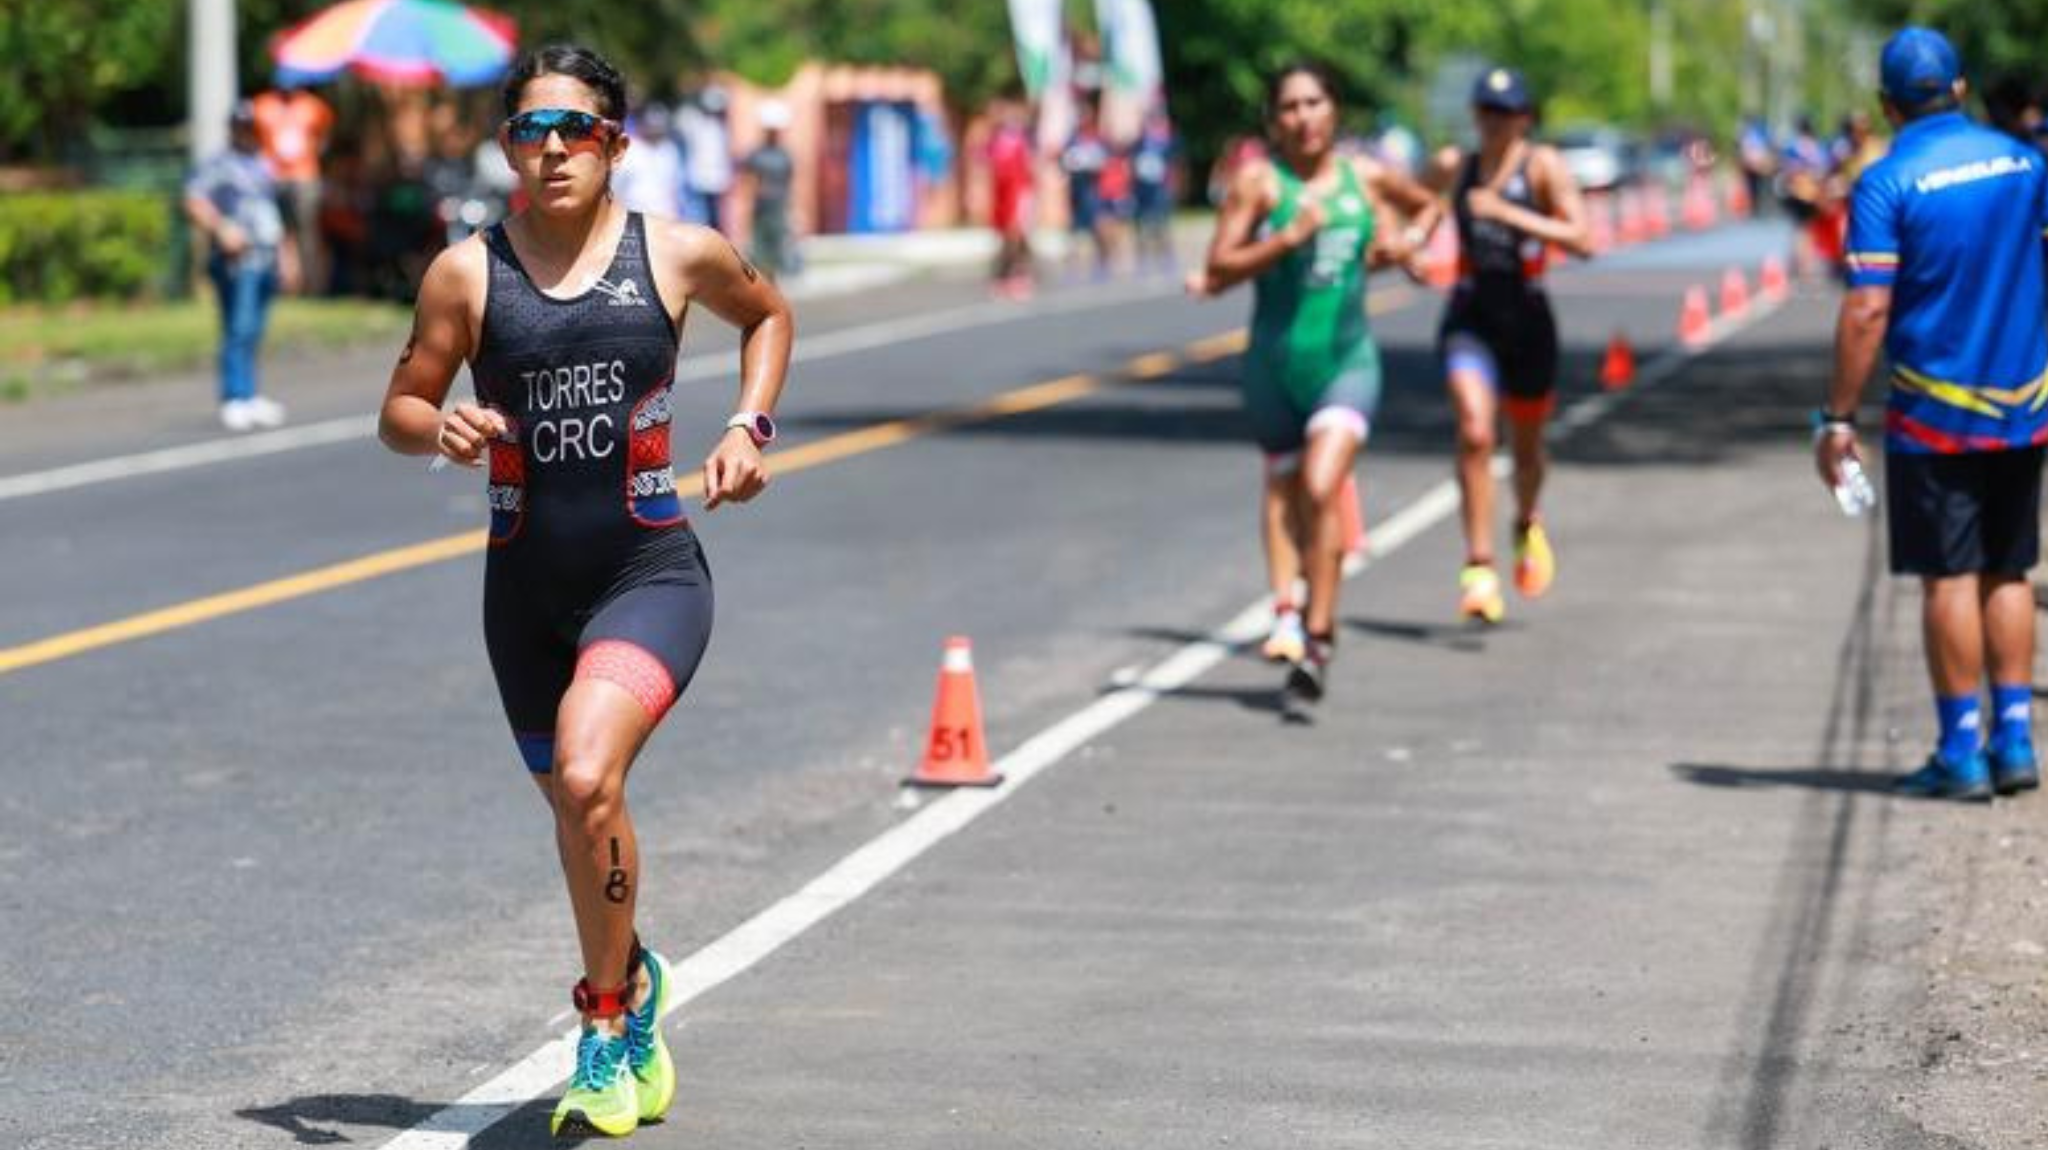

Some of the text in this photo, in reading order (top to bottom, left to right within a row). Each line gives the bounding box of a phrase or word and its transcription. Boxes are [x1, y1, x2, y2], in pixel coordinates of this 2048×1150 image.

[520, 360, 625, 411] TORRES
[533, 413, 615, 463] CRC
[931, 728, 970, 762] 51
